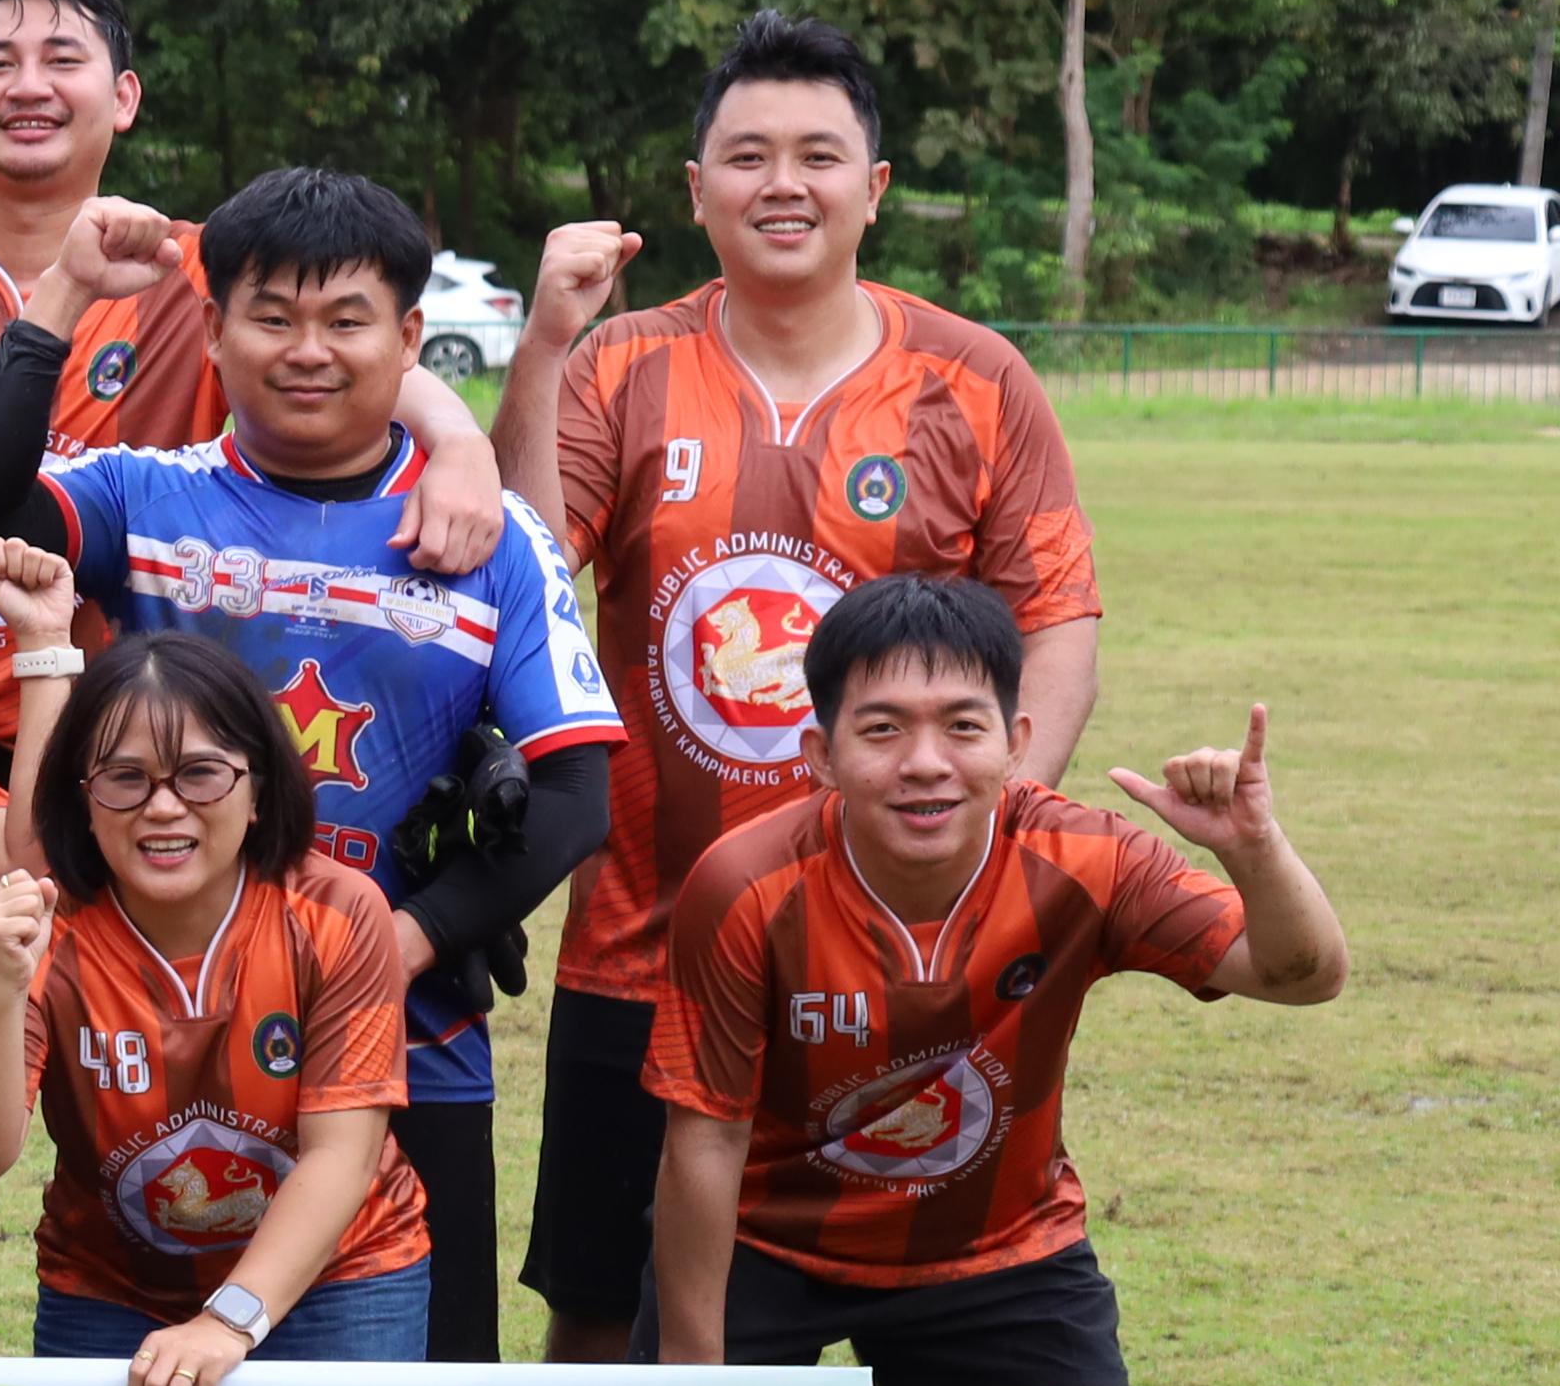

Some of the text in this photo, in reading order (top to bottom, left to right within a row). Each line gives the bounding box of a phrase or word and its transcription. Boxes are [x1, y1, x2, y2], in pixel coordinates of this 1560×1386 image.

[662, 437, 702, 503] 9
[170, 534, 268, 620] 33
[650, 547, 708, 621] PUBLIC
[715, 531, 854, 589] ADMINISTRA
[676, 733, 779, 785] KAMPHAENG
[790, 992, 869, 1047] 64
[79, 1026, 151, 1094] 48
[810, 1073, 868, 1112] PUBLIC
[100, 1132, 151, 1179] PUBLIC
